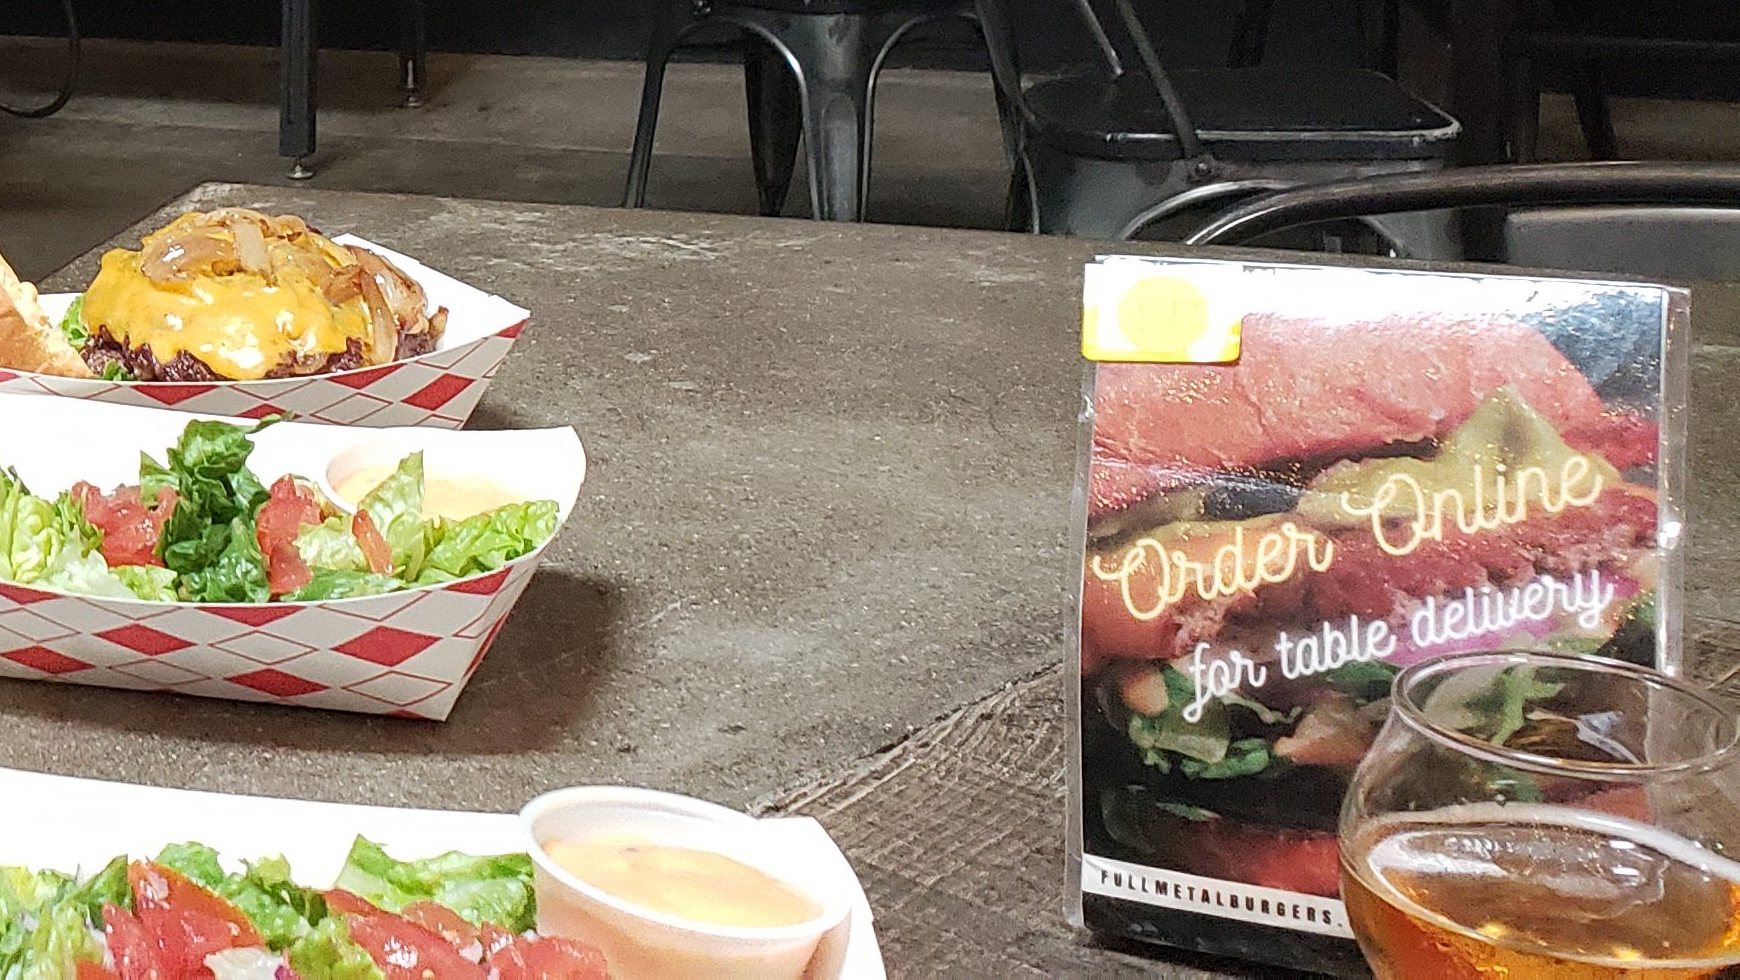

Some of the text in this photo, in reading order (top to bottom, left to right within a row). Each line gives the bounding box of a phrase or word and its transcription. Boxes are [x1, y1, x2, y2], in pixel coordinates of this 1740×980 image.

[1092, 455, 1603, 622] Order Online
[1183, 568, 1615, 723] for table delivery
